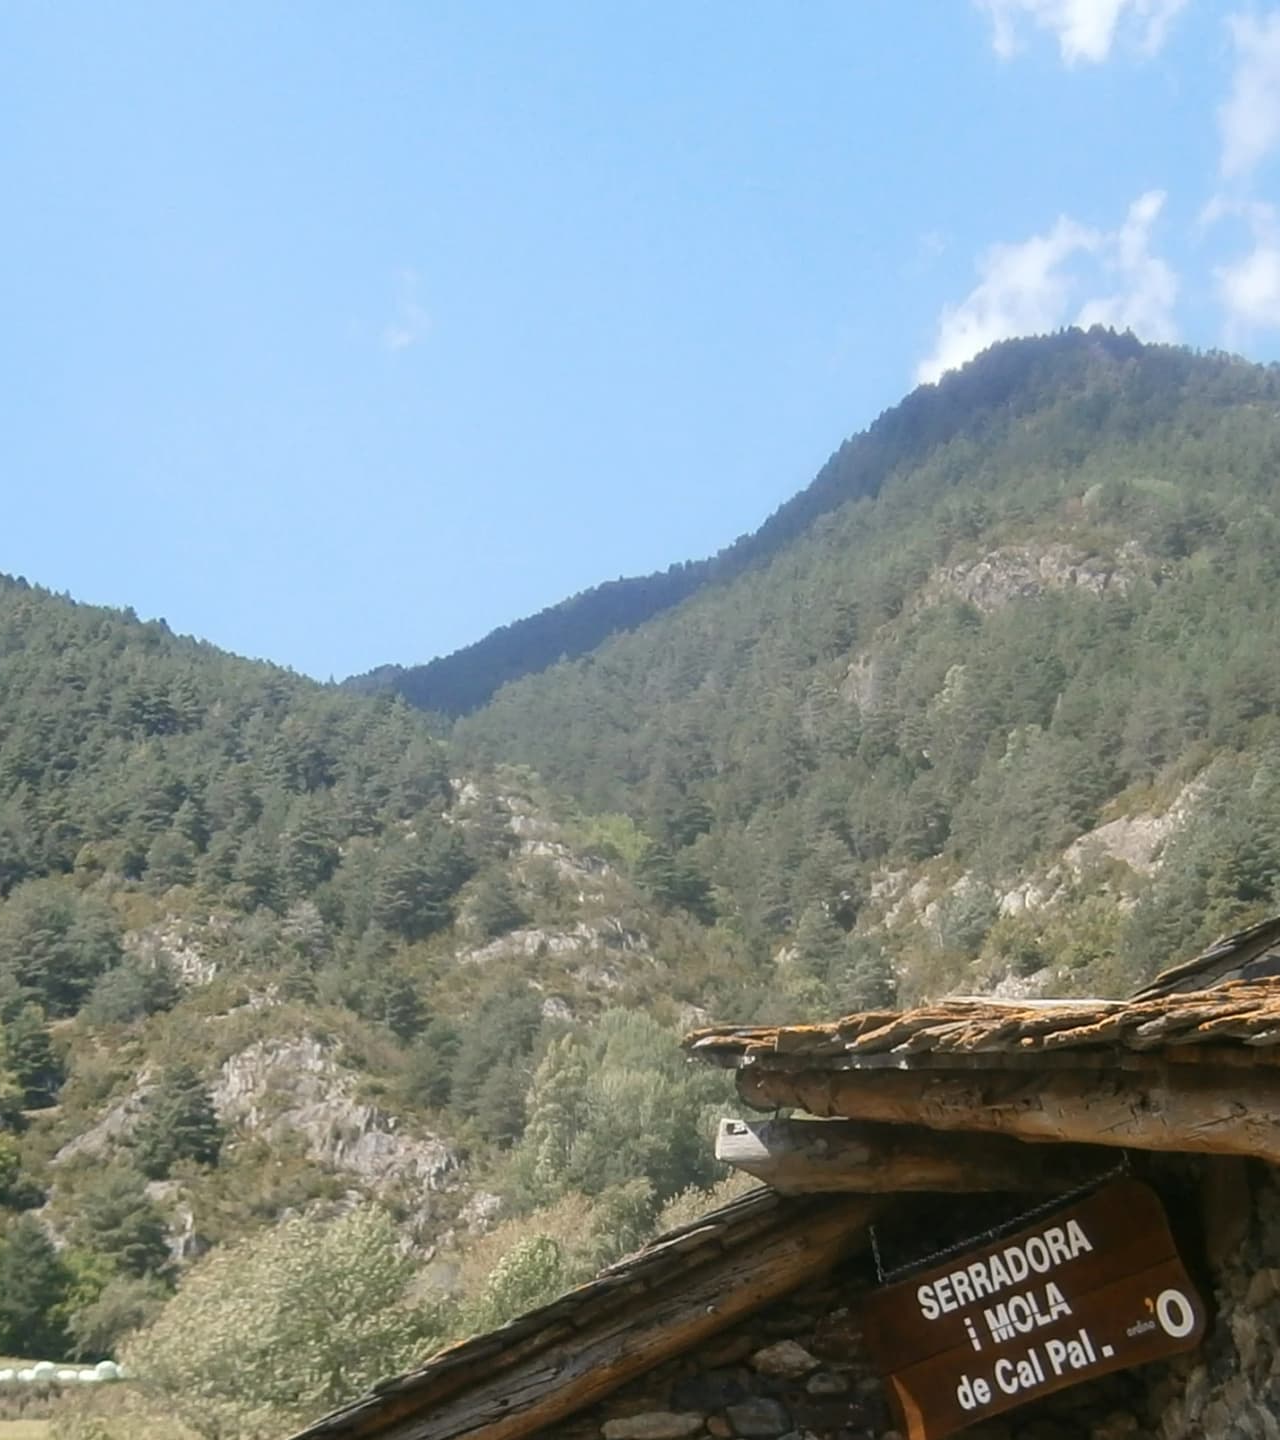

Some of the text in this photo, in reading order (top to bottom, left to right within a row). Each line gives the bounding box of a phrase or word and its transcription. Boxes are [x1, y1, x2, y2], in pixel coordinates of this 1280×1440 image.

[917, 1219, 1093, 1321] SERRADORA
[963, 1281, 1073, 1352] i MOLA
[956, 1374, 992, 1411] de
[994, 1348, 1045, 1395] Cal
